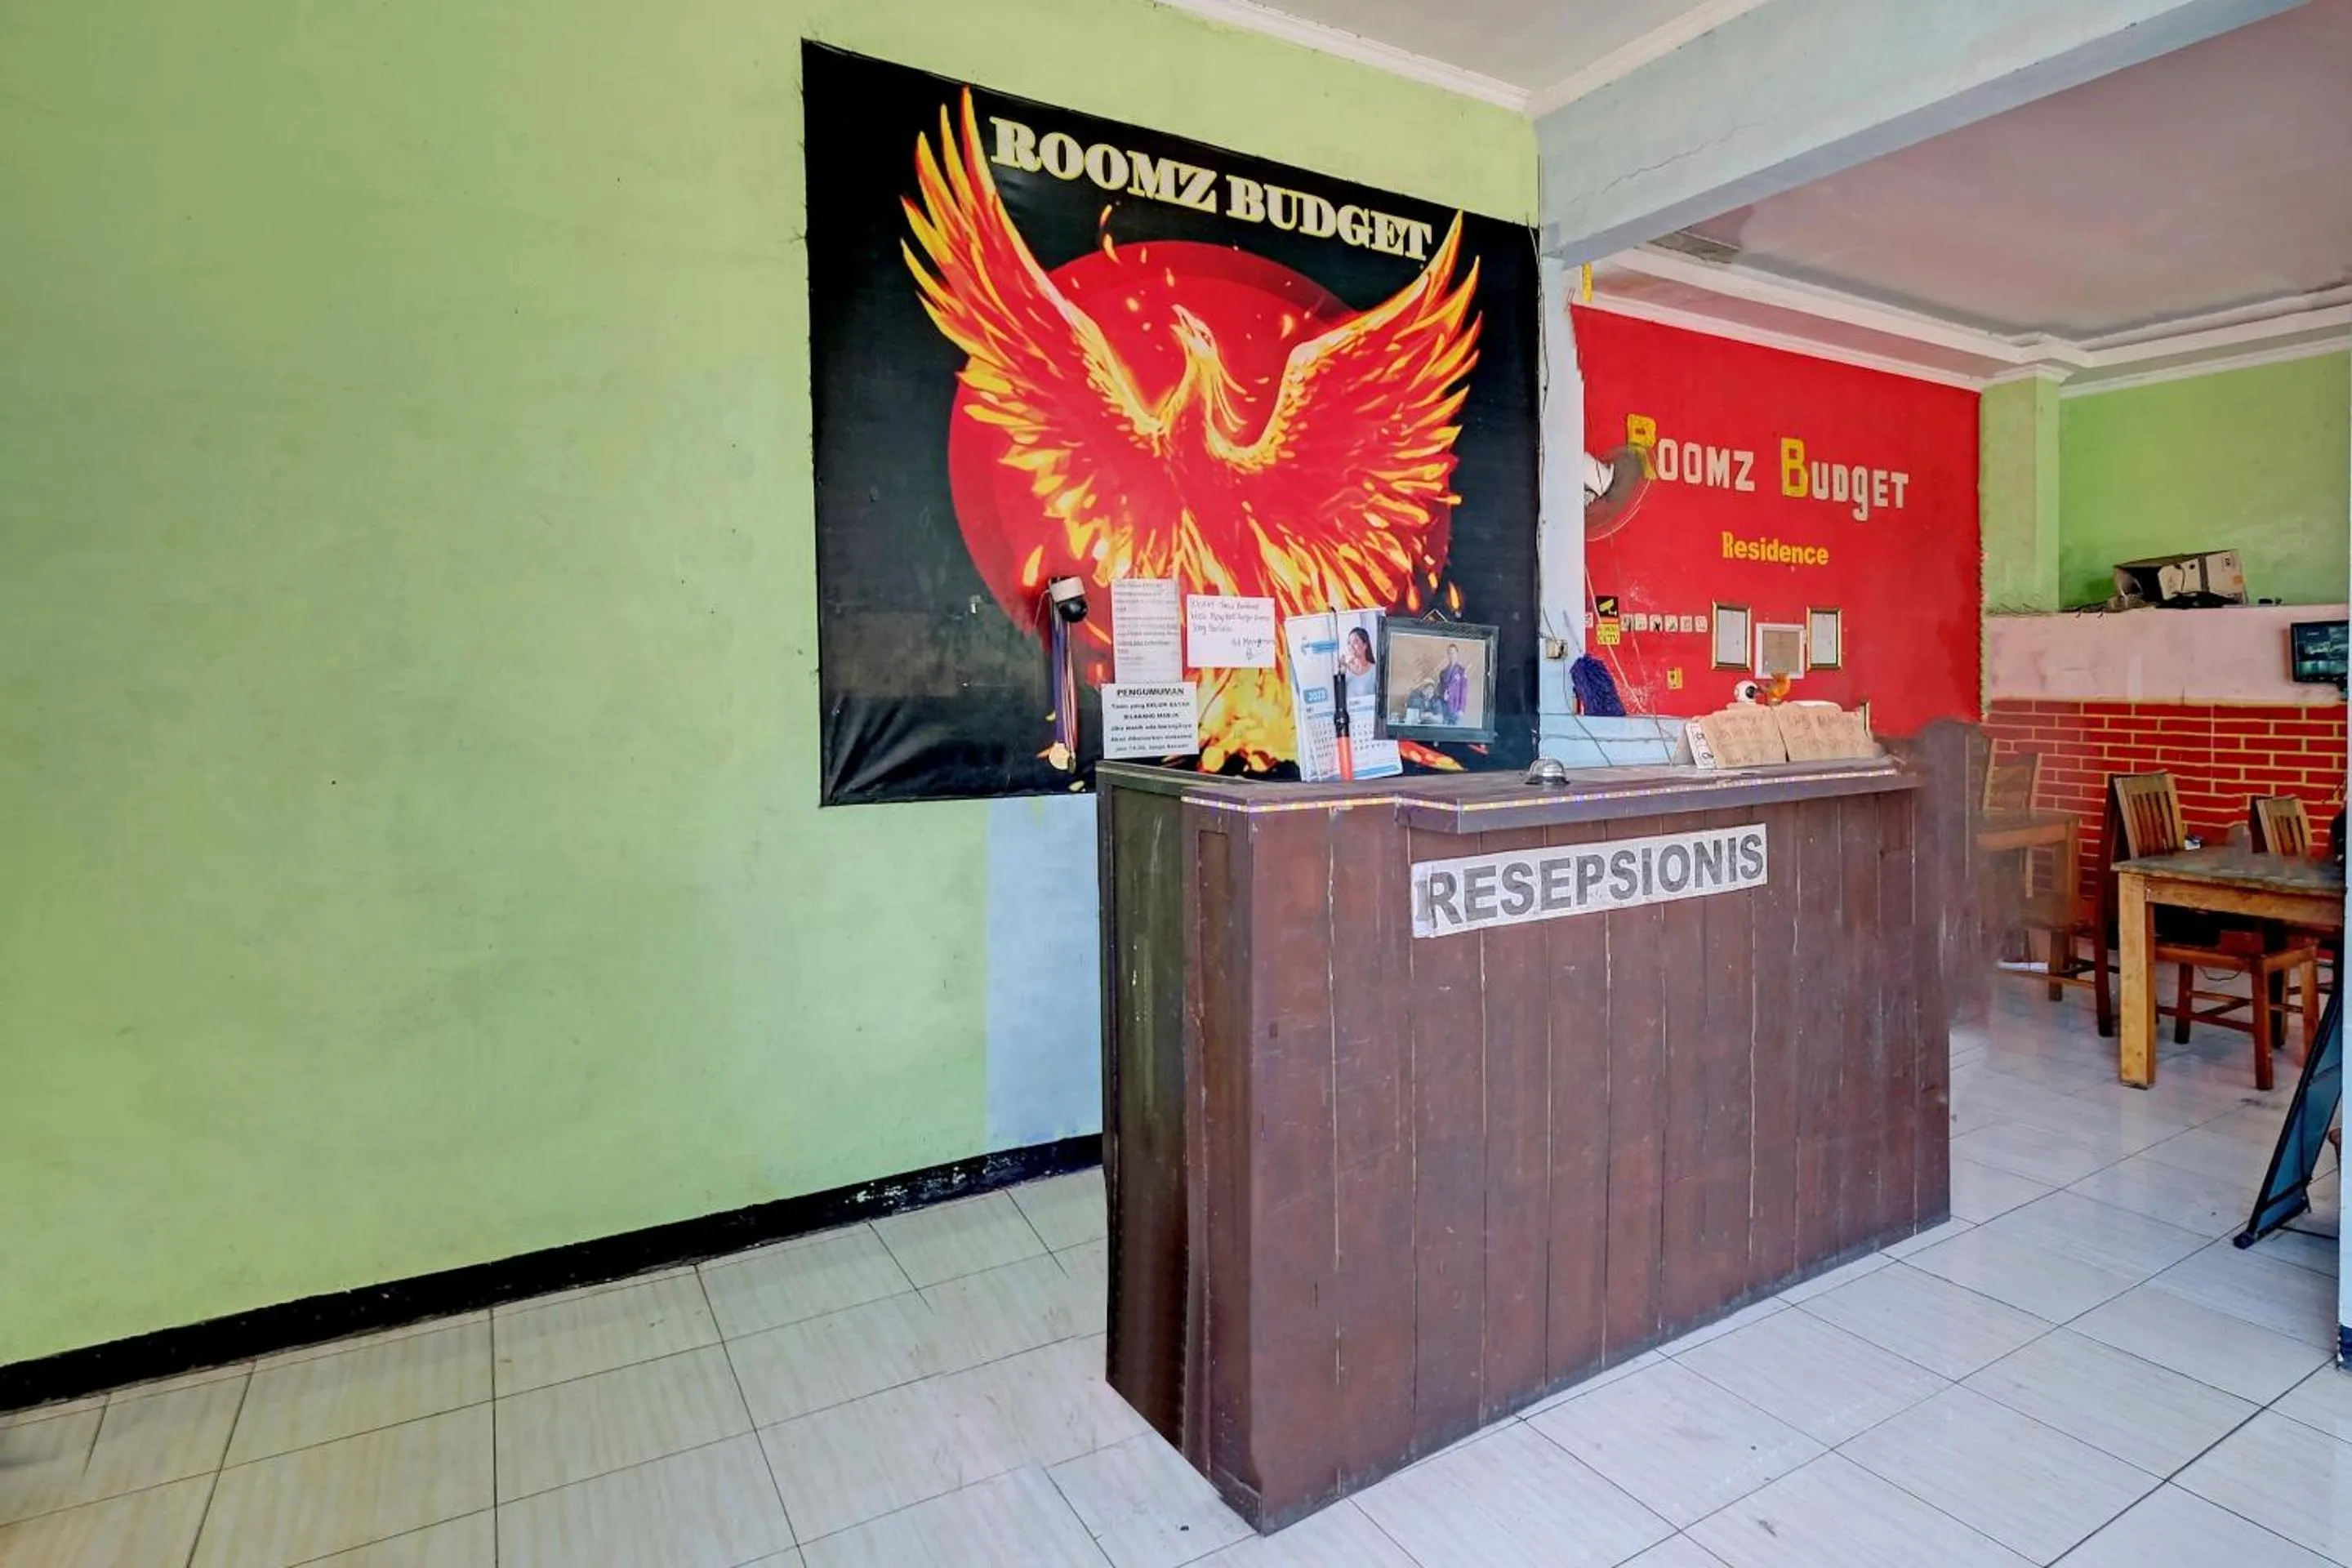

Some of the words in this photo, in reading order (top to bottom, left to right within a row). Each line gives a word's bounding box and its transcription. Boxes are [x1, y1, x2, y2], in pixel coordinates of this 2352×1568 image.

[989, 116, 1217, 214] ROOMZ
[1227, 174, 1432, 261] BUDGET
[1627, 413, 1755, 492] ROOMZ
[1722, 531, 1829, 565] Residence
[1417, 834, 1763, 929] RESEPSIONIS
